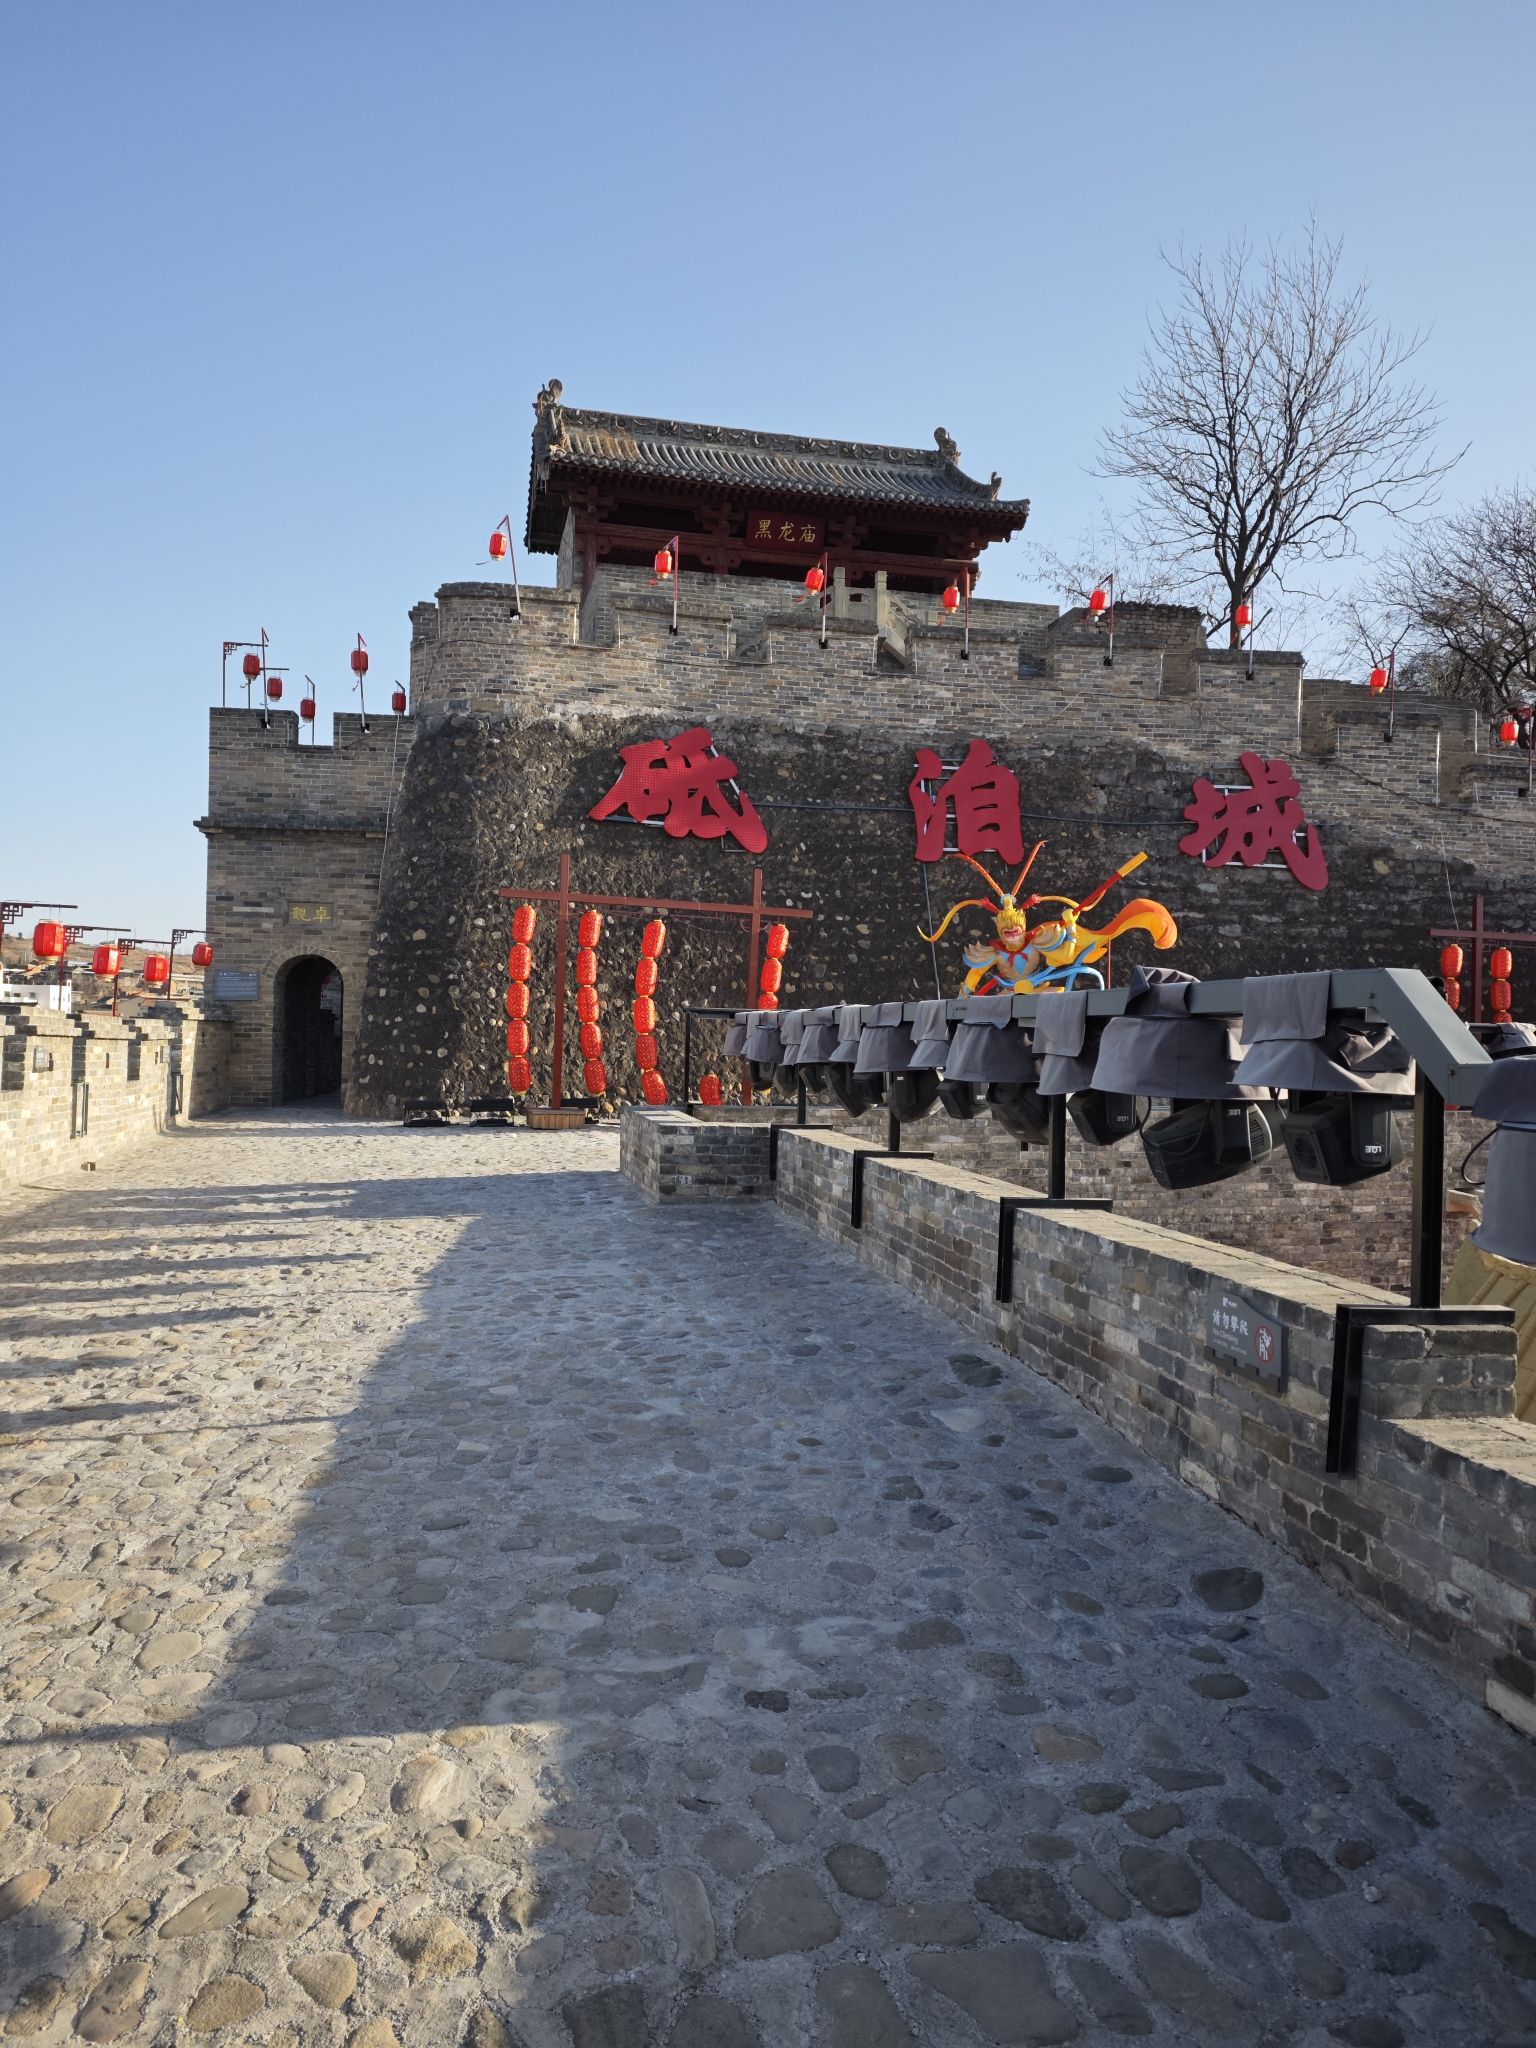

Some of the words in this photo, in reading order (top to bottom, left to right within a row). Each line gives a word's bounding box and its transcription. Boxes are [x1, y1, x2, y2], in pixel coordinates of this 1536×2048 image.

[754, 519, 817, 543] 黑龙庙
[1212, 1309, 1249, 1336] 请勿攀爬
